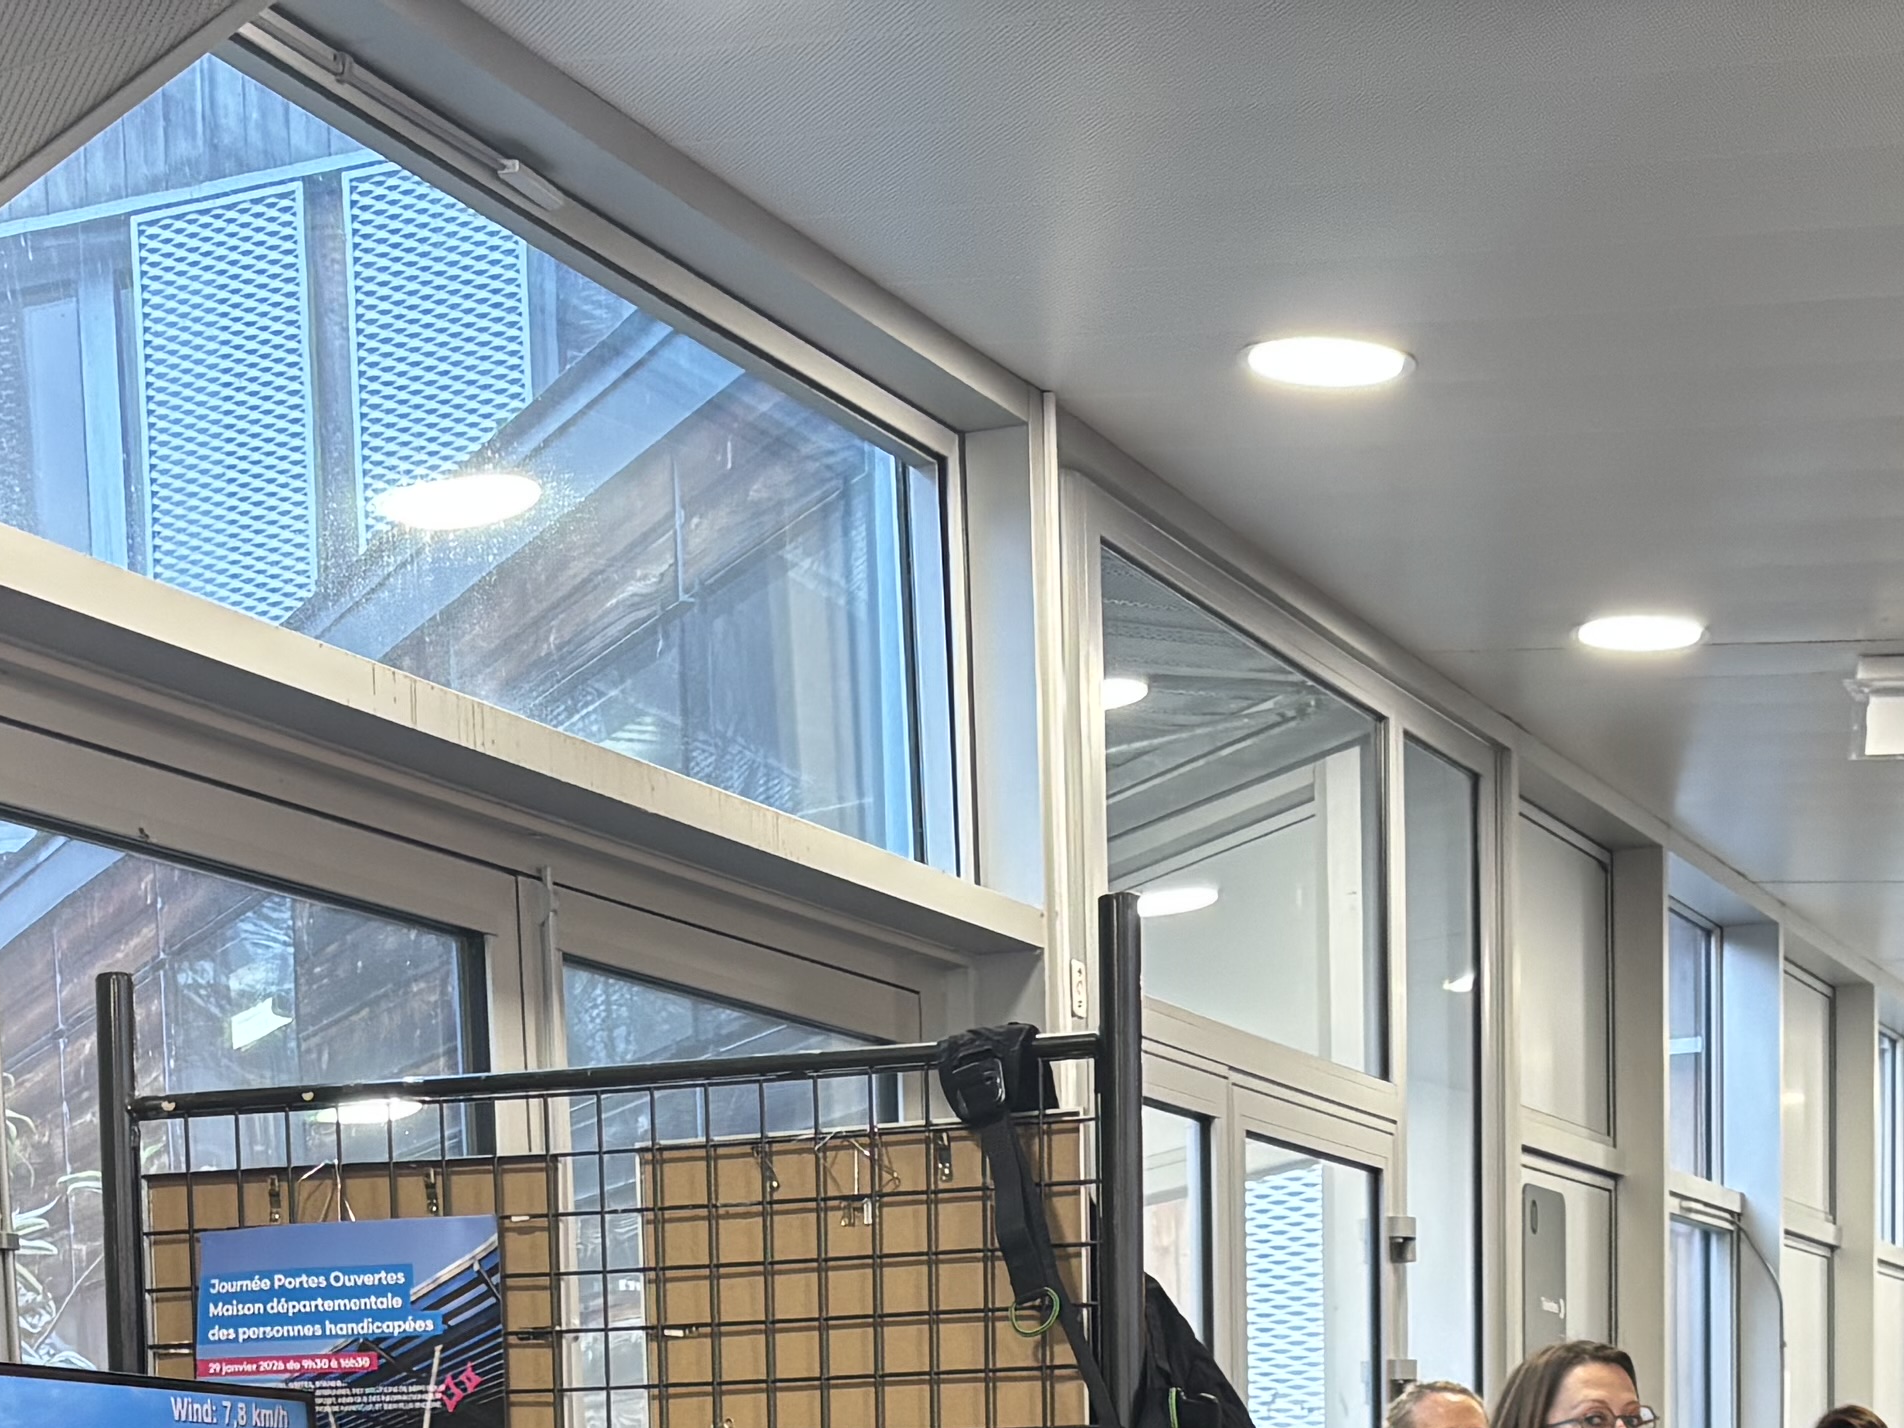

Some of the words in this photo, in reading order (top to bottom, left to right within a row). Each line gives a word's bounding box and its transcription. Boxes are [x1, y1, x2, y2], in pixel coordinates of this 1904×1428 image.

[209, 1275, 271, 1294] Journée
[274, 1273, 327, 1290] Portes
[329, 1270, 406, 1287] Ouvertes
[209, 1301, 264, 1318] Maison
[267, 1293, 403, 1317] départementale
[208, 1325, 236, 1342] des
[238, 1324, 322, 1344] personnes
[325, 1315, 435, 1337] handicapées
[222, 1361, 257, 1375] janvier
[170, 1396, 218, 1424] Wind:
